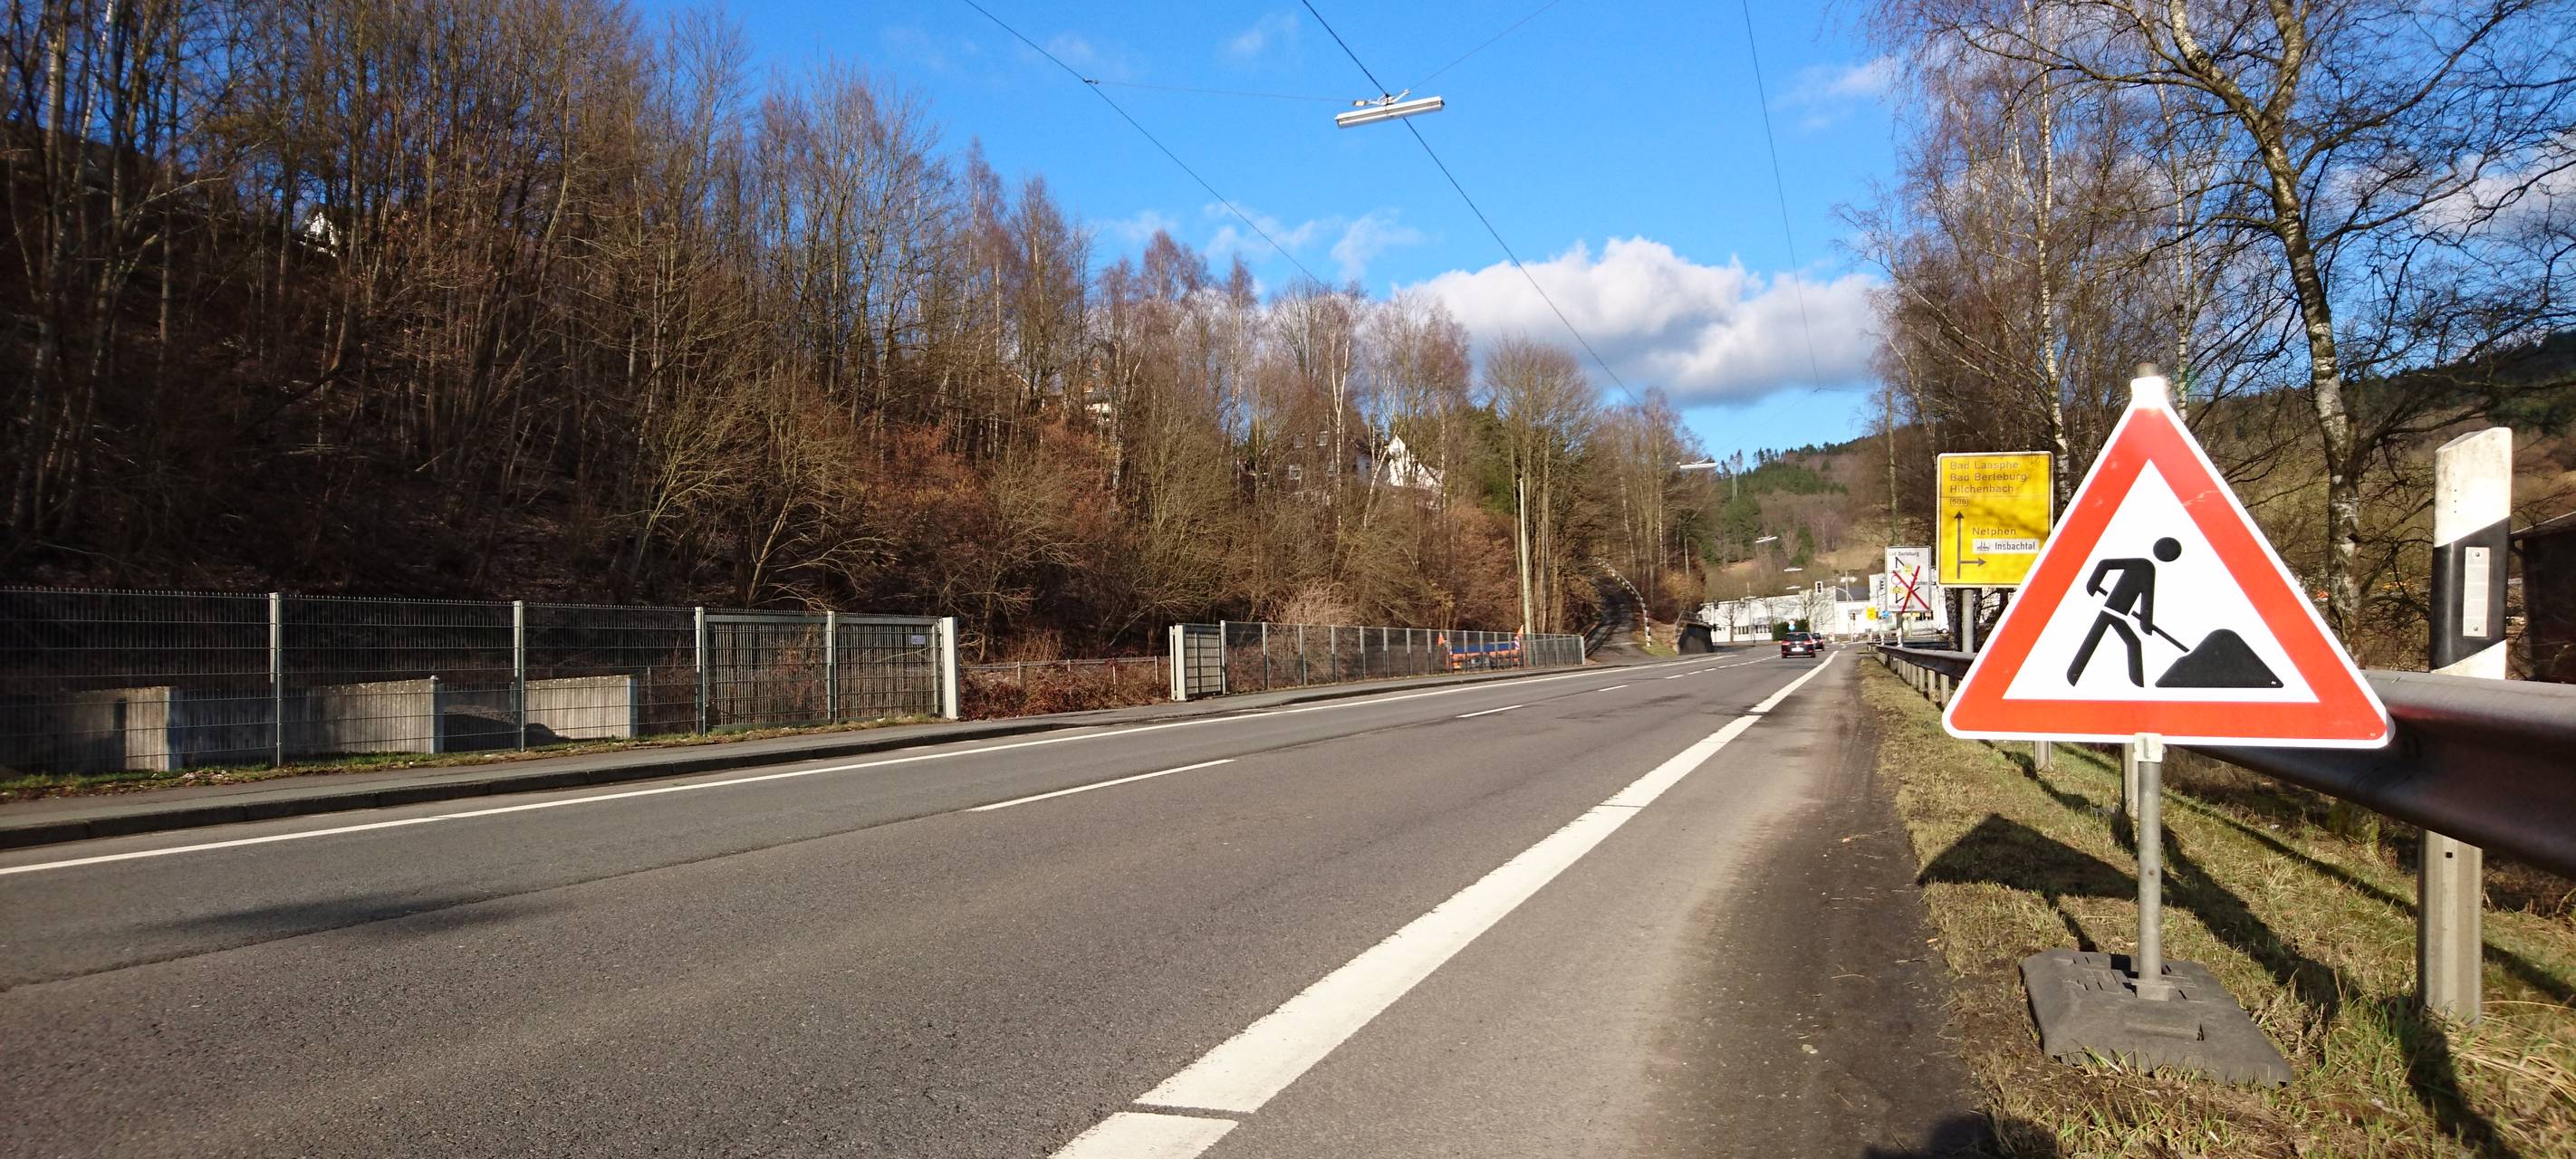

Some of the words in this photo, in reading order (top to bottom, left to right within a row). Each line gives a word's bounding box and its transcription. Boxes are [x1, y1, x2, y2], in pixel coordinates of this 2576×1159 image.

[1950, 461, 1969, 470] Bad
[1950, 474, 1970, 482] Bad
[1975, 472, 2028, 483] Berleburg
[1949, 484, 2014, 493] Hilchenbach
[1972, 527, 2016, 537] Netphen
[1994, 541, 2036, 551] Insbachtal
